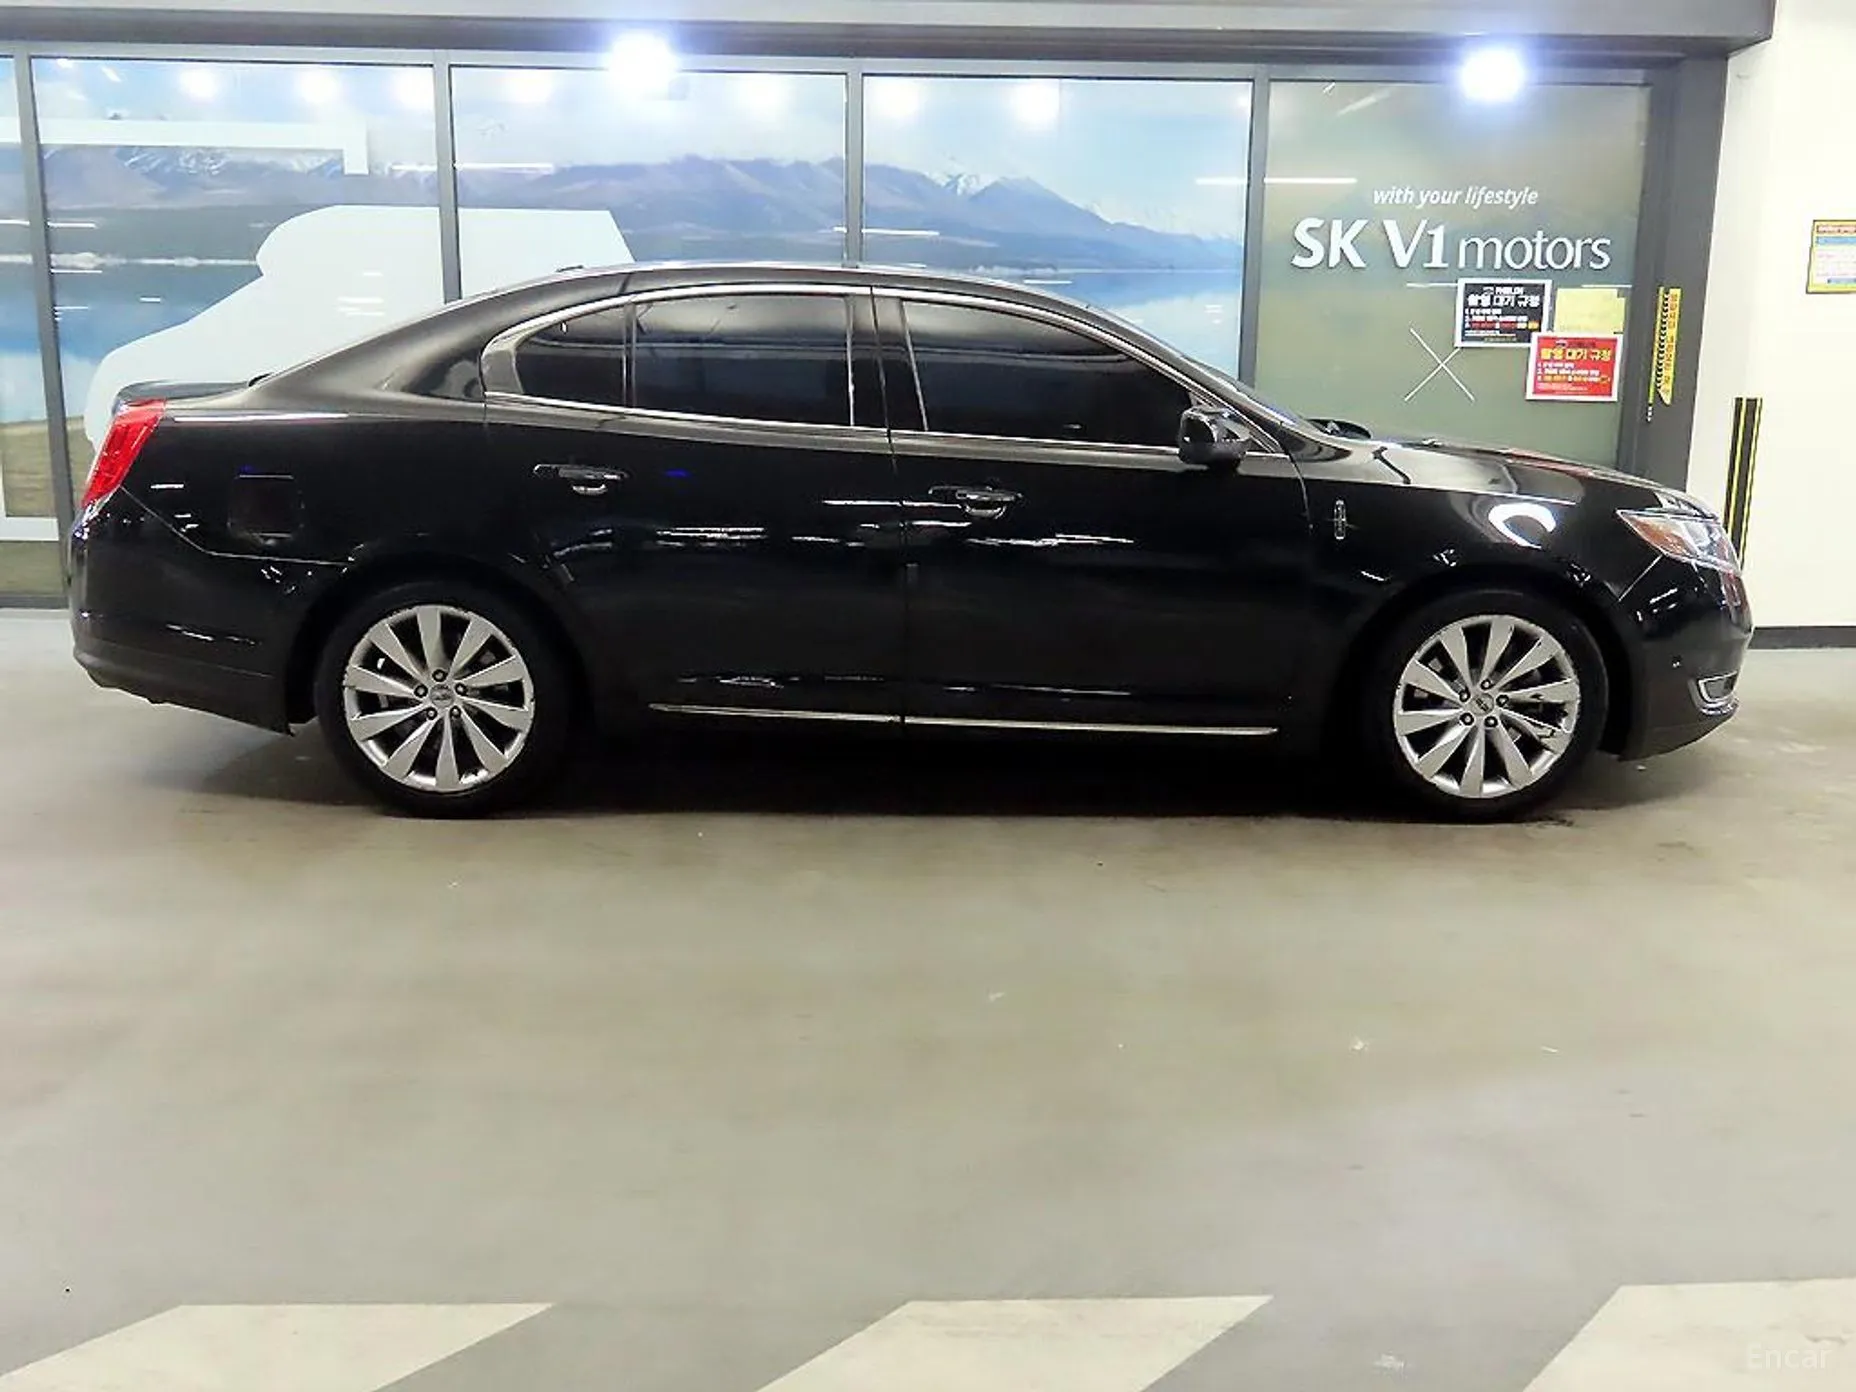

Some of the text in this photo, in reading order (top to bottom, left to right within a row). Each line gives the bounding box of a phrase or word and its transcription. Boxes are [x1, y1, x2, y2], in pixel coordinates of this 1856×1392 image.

[1373, 185, 1539, 209] with your lifestyle
[1291, 216, 1612, 271] SK V1 motors
